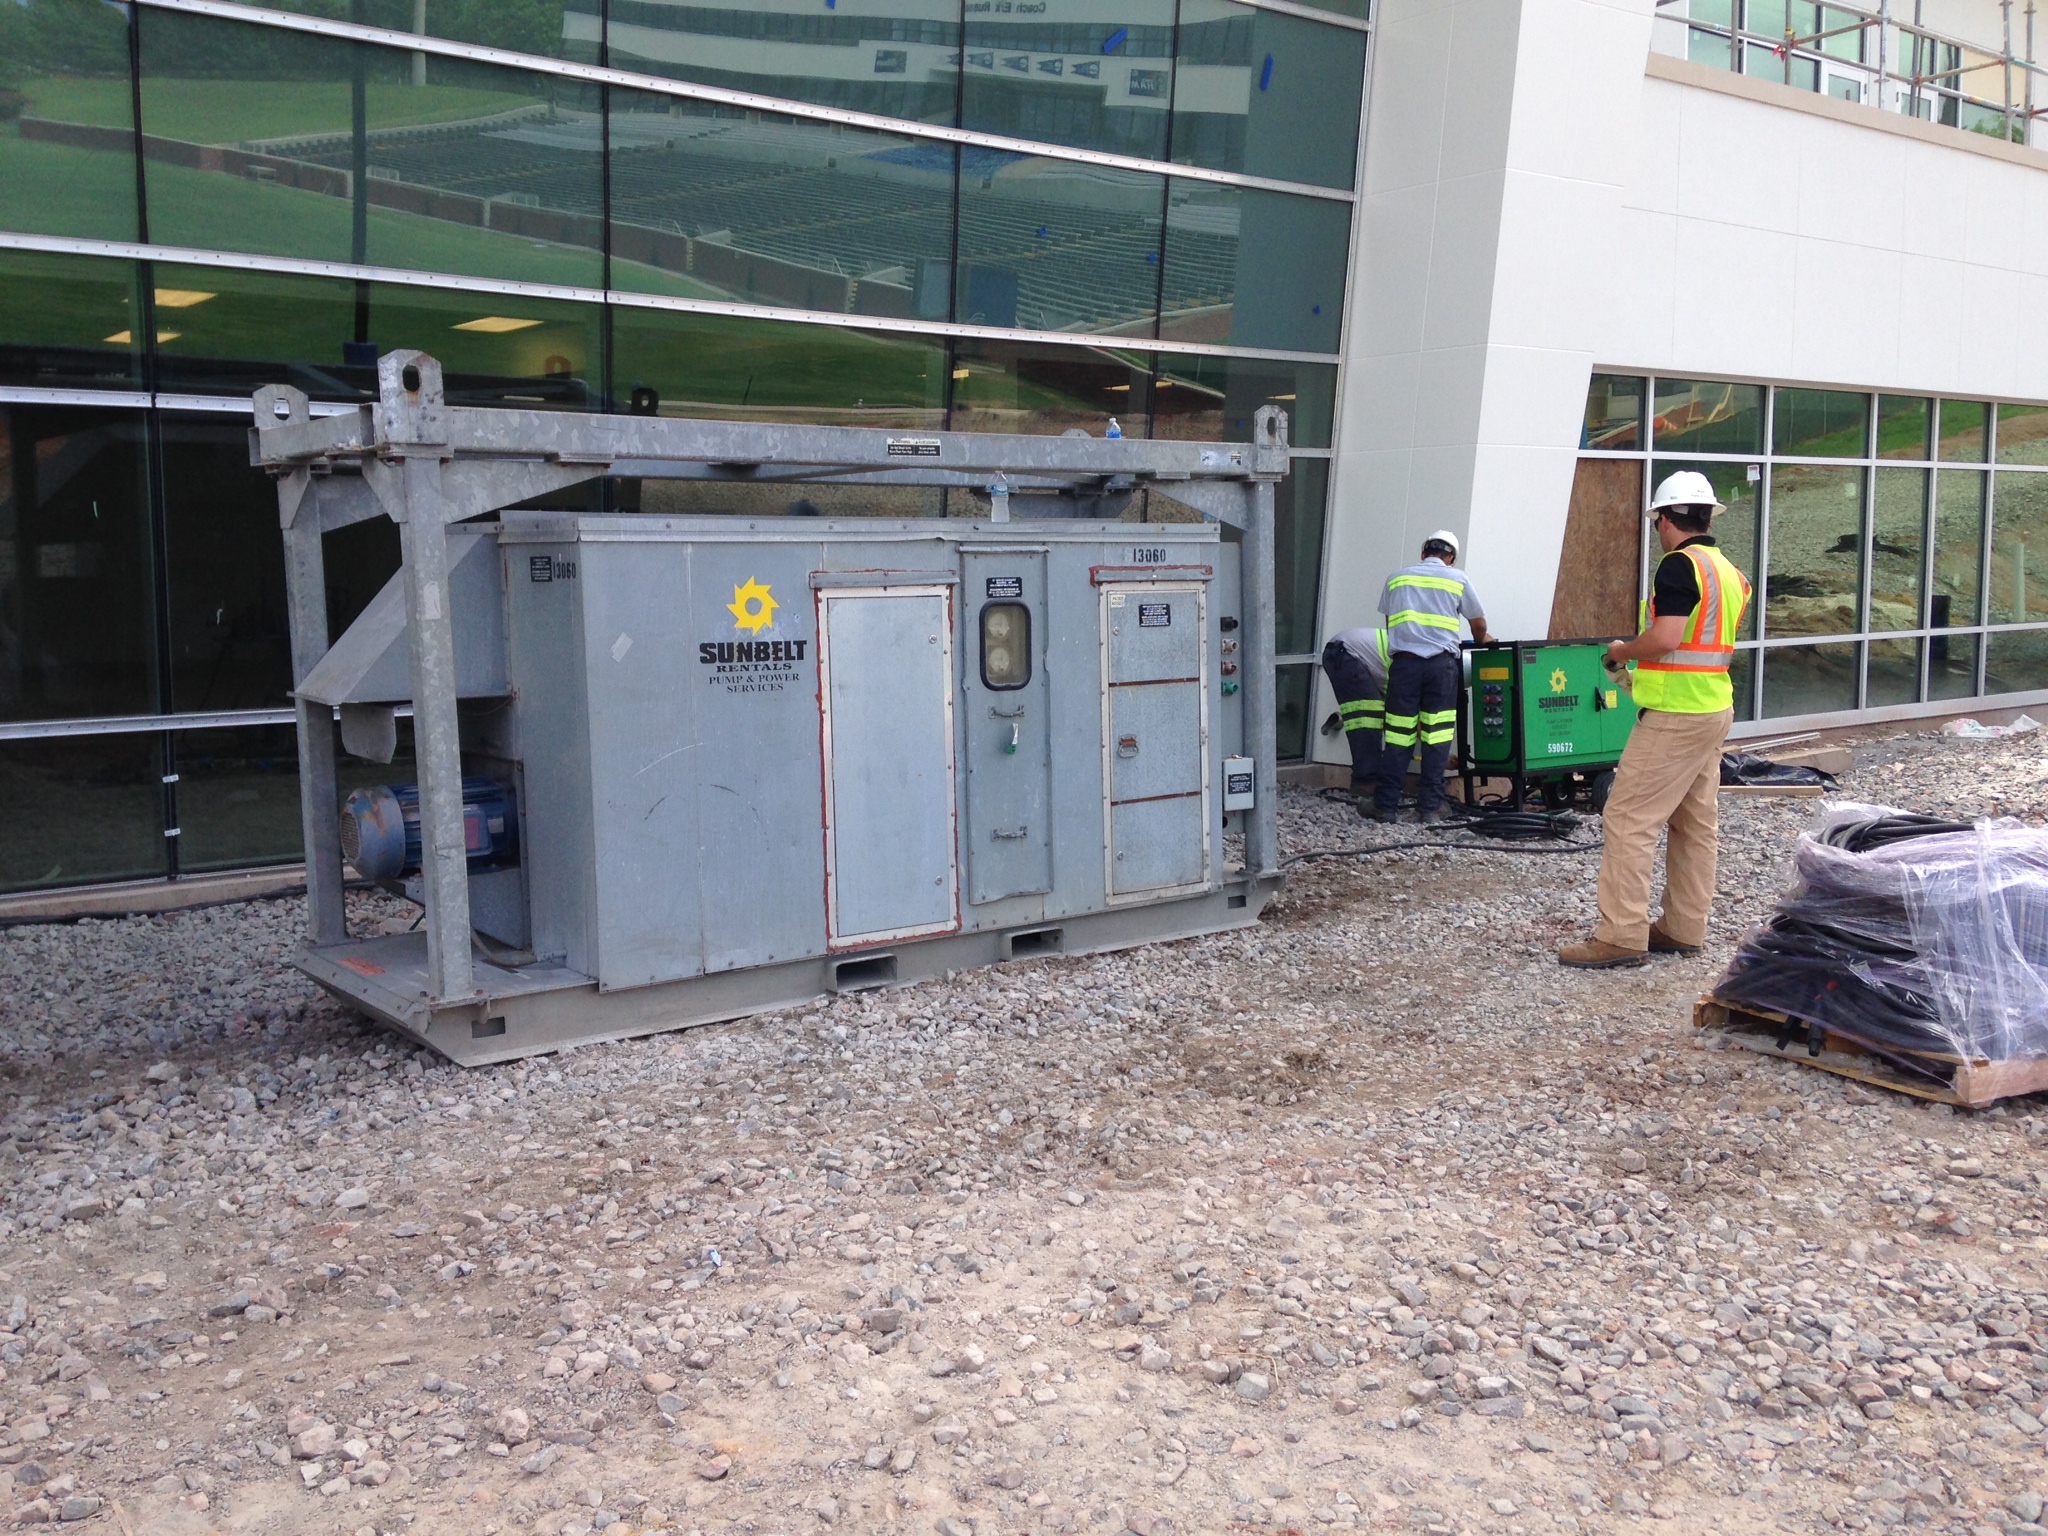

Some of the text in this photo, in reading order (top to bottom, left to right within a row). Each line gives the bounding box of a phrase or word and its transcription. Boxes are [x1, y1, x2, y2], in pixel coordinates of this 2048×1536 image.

[1133, 548, 1166, 562] 13060
[552, 561, 576, 579] 13060
[699, 640, 807, 664] SUNBELT
[716, 663, 792, 673] RENTALS
[709, 673, 800, 684] PUMP & POWER
[726, 683, 784, 693] SERVICES
[1538, 695, 1579, 708] SUNBELT
[1548, 742, 1573, 753] 590672
